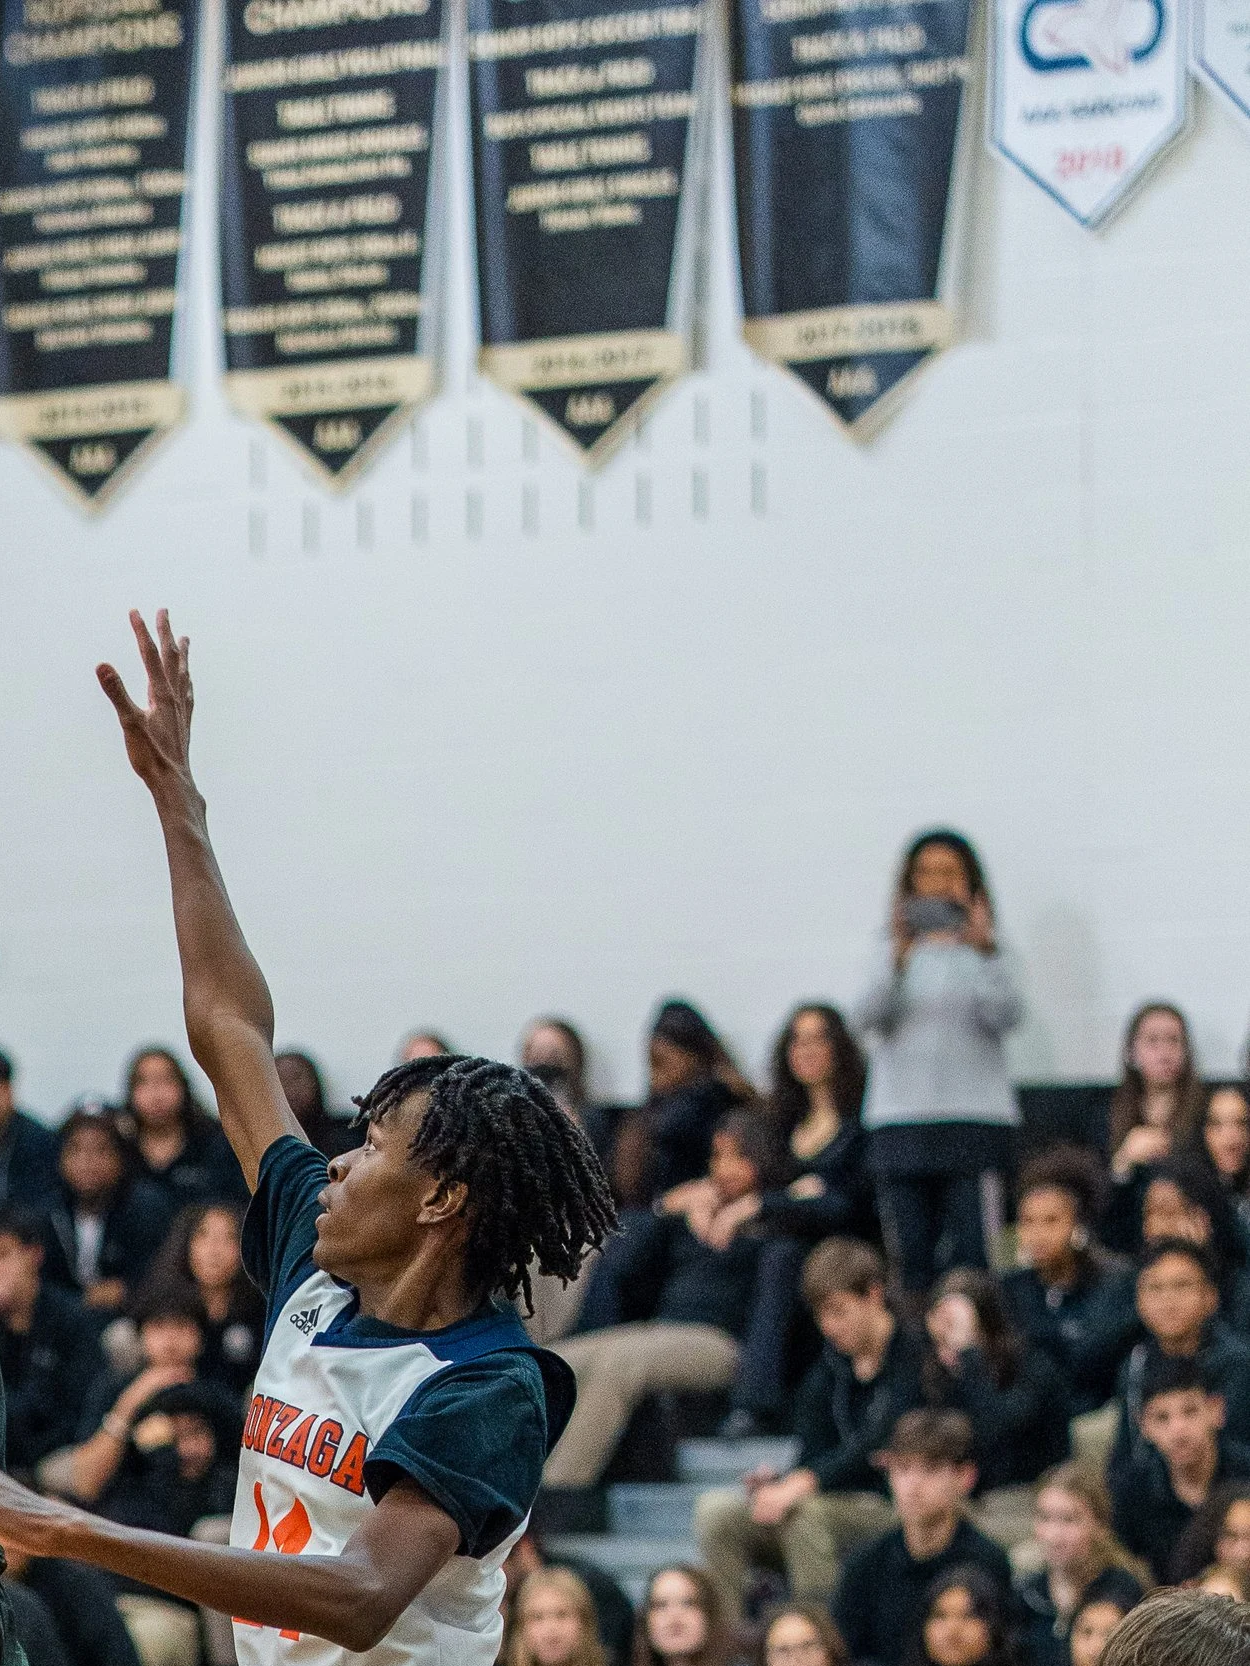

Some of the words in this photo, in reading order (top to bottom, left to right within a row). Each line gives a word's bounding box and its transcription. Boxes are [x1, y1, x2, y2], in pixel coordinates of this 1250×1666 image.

[4, 12, 184, 67] CHAMPIONS
[289, 1313, 315, 1337] adid
[241, 1393, 370, 1497] ONZAGA
